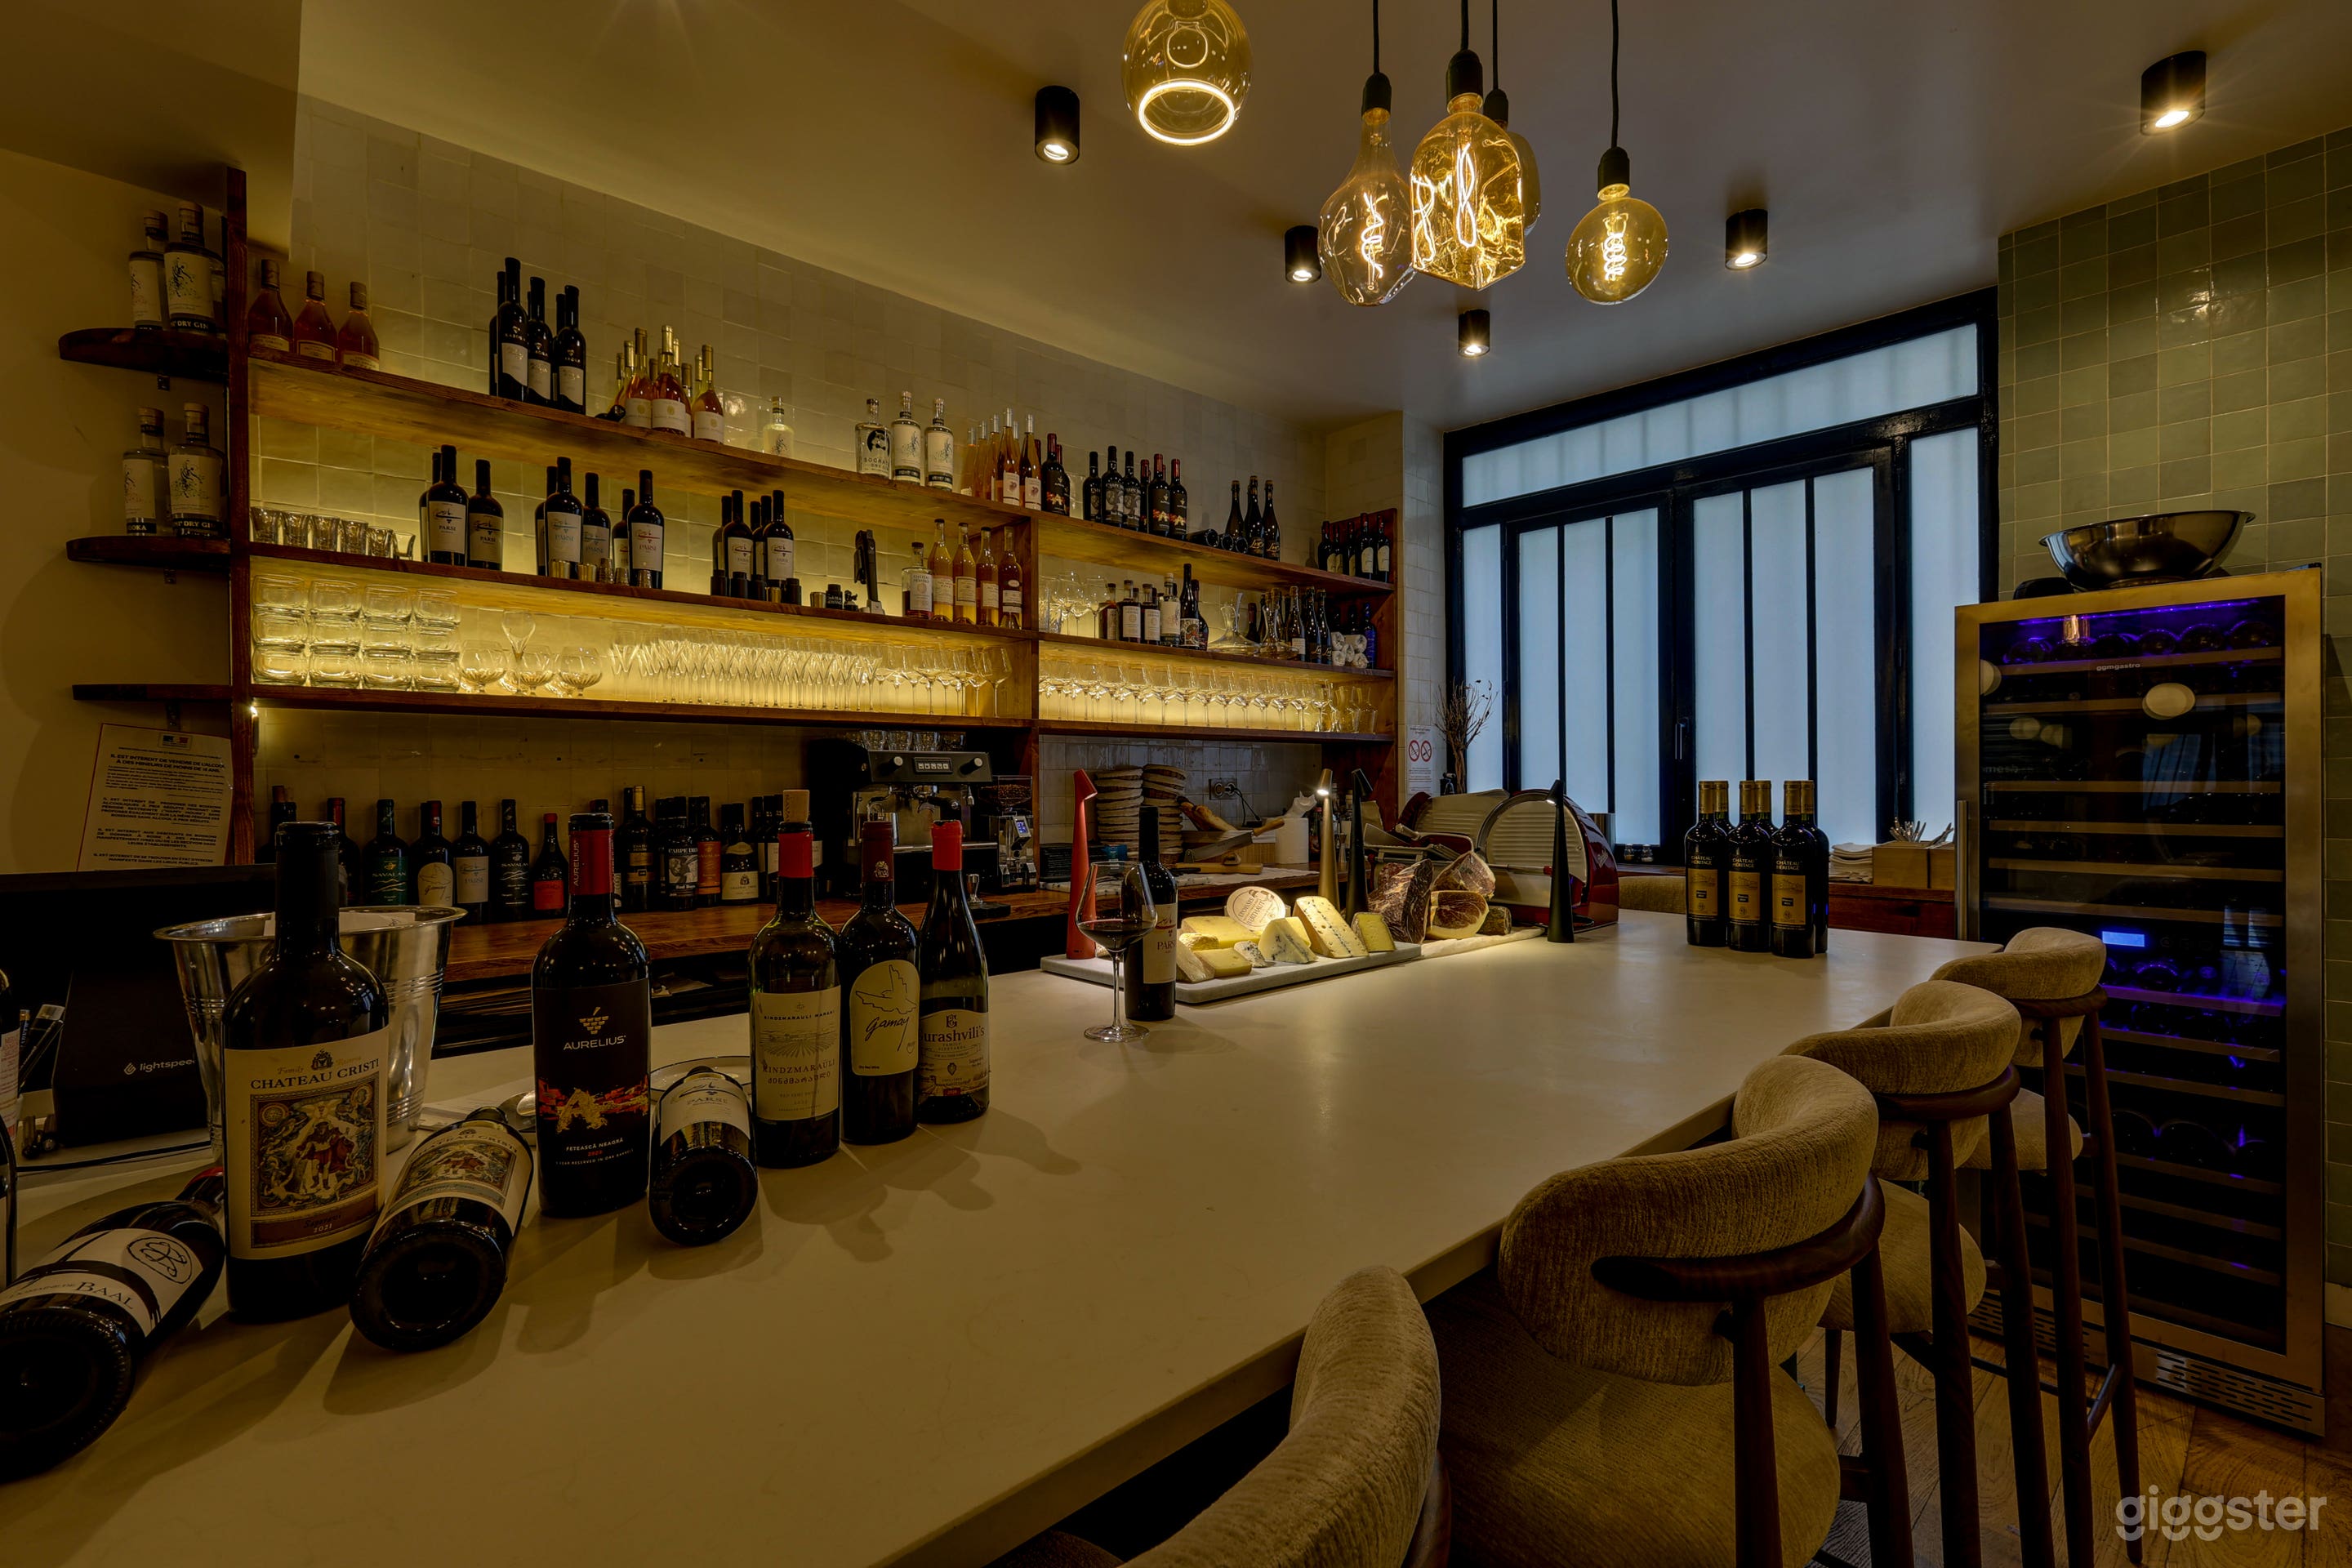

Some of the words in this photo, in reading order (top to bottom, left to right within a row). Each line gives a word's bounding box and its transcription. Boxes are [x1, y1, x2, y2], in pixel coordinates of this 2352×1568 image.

[2096, 663, 2140, 671] ggmgastro
[563, 1036, 625, 1051] AURELIUS
[251, 1071, 333, 1089] CHATEAU
[336, 1058, 380, 1078] CRISTI
[74, 1281, 134, 1310] BAAL
